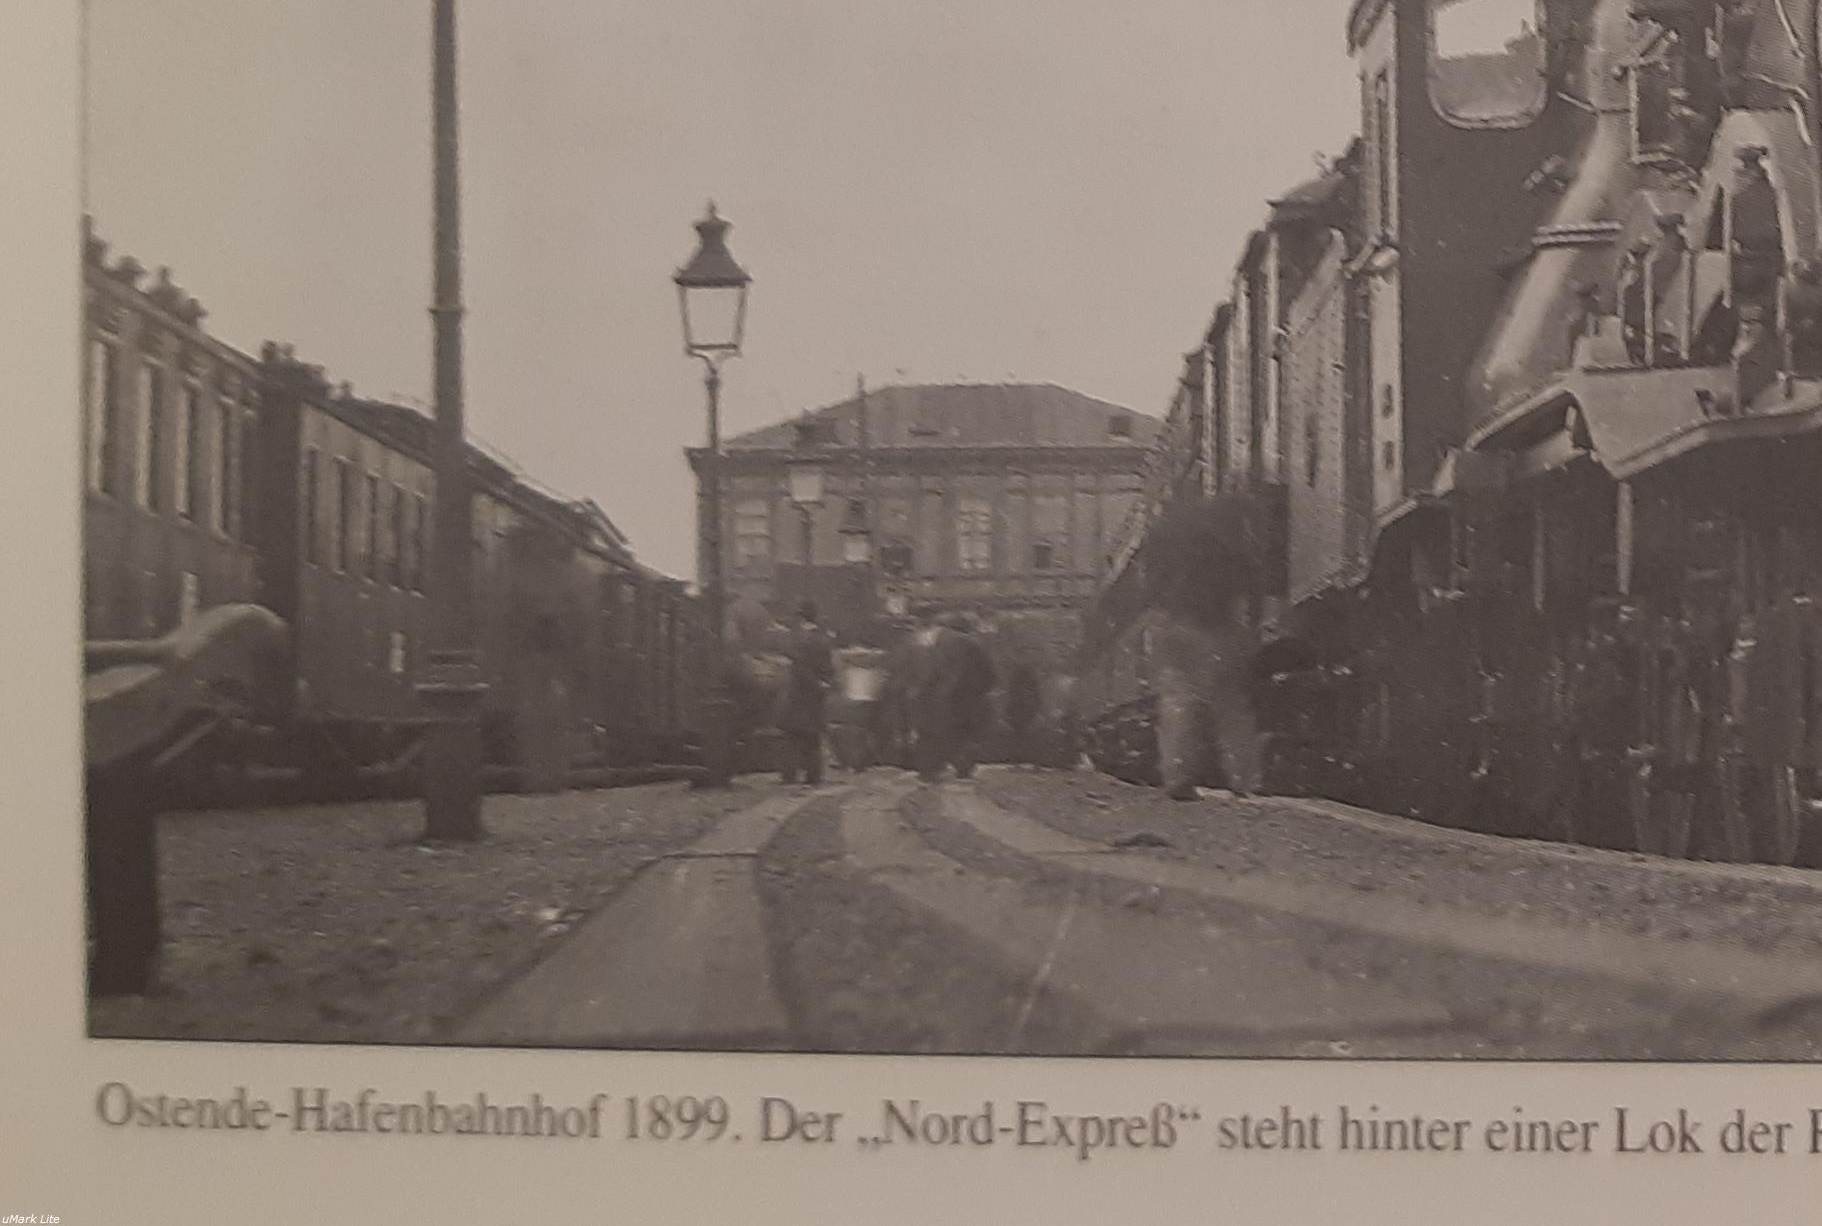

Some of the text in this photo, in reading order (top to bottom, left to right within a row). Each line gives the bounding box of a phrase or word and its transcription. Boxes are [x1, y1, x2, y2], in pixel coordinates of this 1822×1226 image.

[96, 1079, 608, 1139] Ostende-Hafenbahnhof
[622, 1094, 742, 1142] 1899.
[760, 1096, 842, 1144] Der
[1217, 1106, 1323, 1151] steht
[1339, 1105, 1472, 1153] hinter
[1484, 1108, 1599, 1154] einer
[1614, 1107, 1702, 1155] Lok
[1719, 1108, 1792, 1155] der
